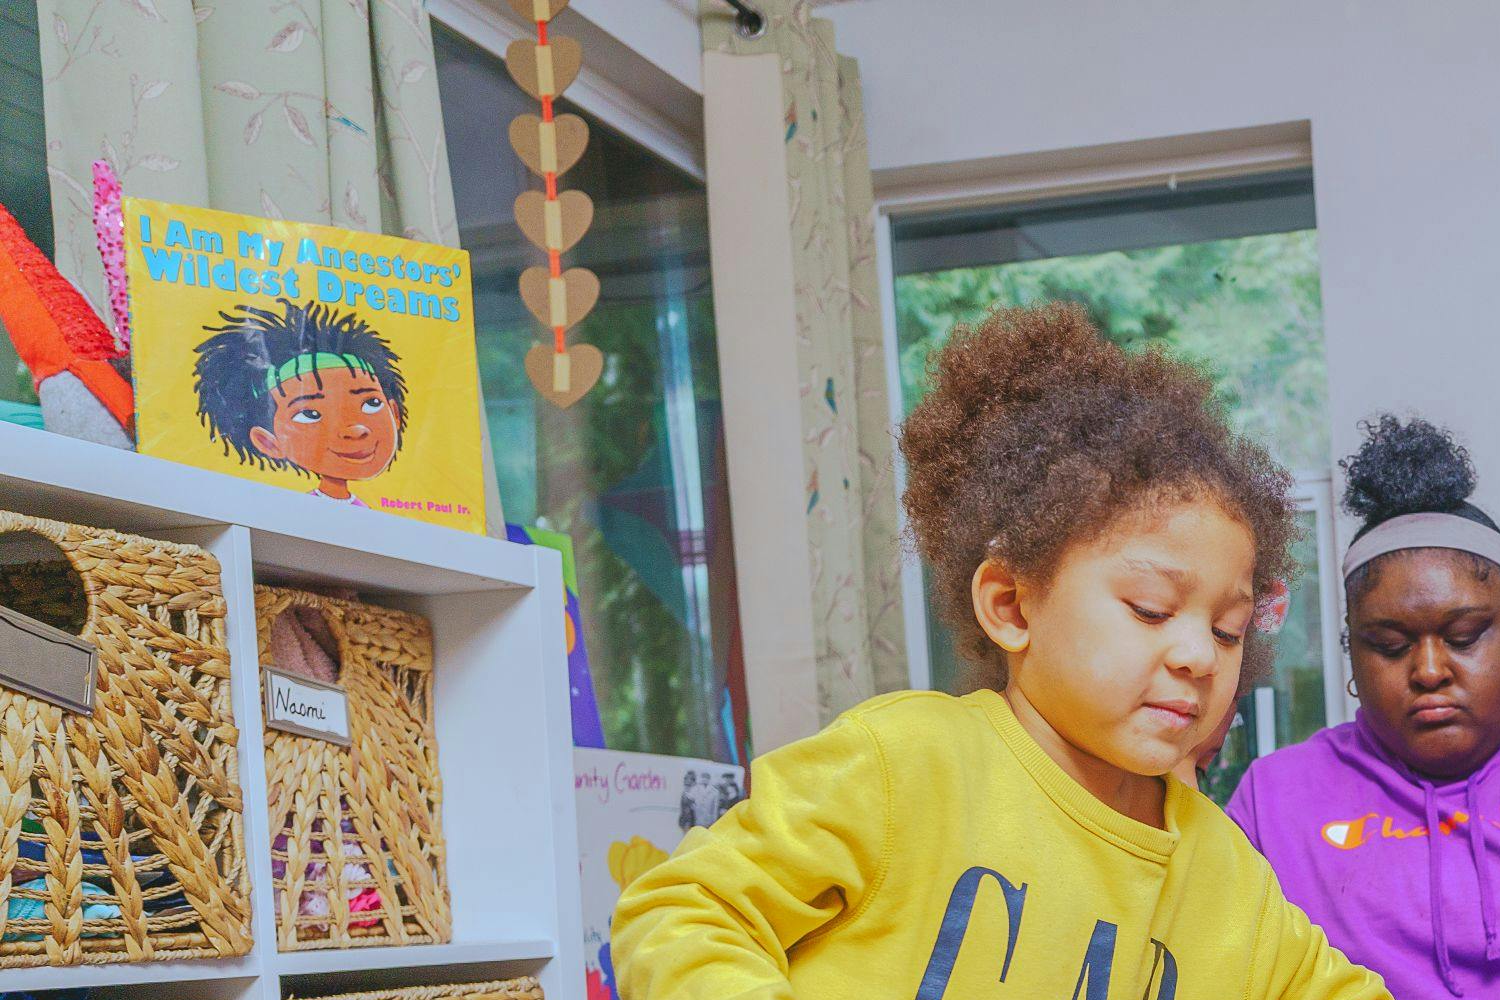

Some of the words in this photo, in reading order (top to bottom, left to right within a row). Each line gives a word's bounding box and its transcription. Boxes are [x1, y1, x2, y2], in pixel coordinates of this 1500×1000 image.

[139, 215, 152, 243] I
[165, 220, 223, 253] Am
[238, 230, 284, 266] My
[297, 238, 461, 287] Ancestors'
[141, 246, 300, 298] Wildest
[317, 269, 460, 322] Dreams
[381, 497, 423, 511] Robert
[427, 501, 453, 513] Paul
[276, 687, 326, 720] Naomi
